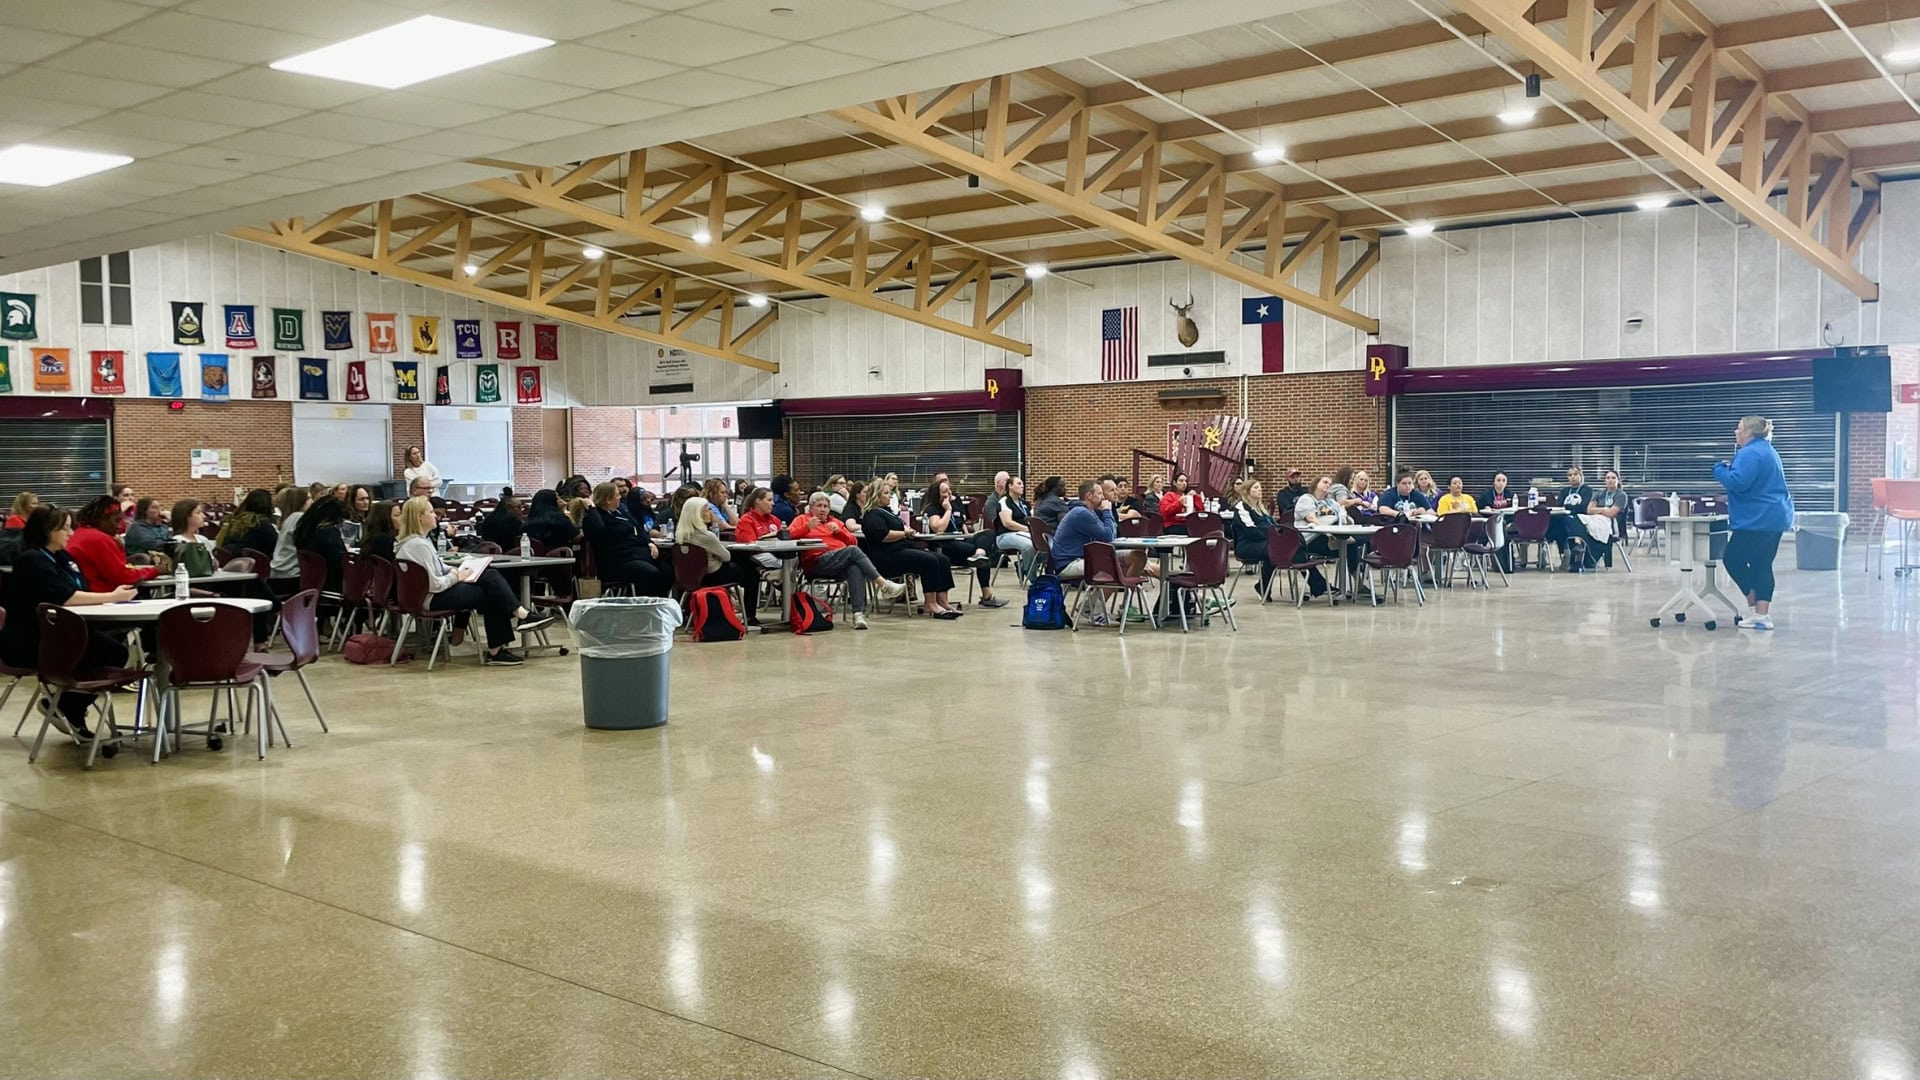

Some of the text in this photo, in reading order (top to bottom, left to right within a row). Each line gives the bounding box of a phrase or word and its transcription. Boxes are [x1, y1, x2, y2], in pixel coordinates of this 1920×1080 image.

[228, 312, 251, 336] A
[279, 315, 299, 341] D
[370, 320, 394, 343] T
[456, 324, 480, 336] TCU
[499, 329, 518, 349] R
[397, 369, 416, 387] M
[1369, 357, 1386, 381] DP
[987, 379, 999, 400] DP
